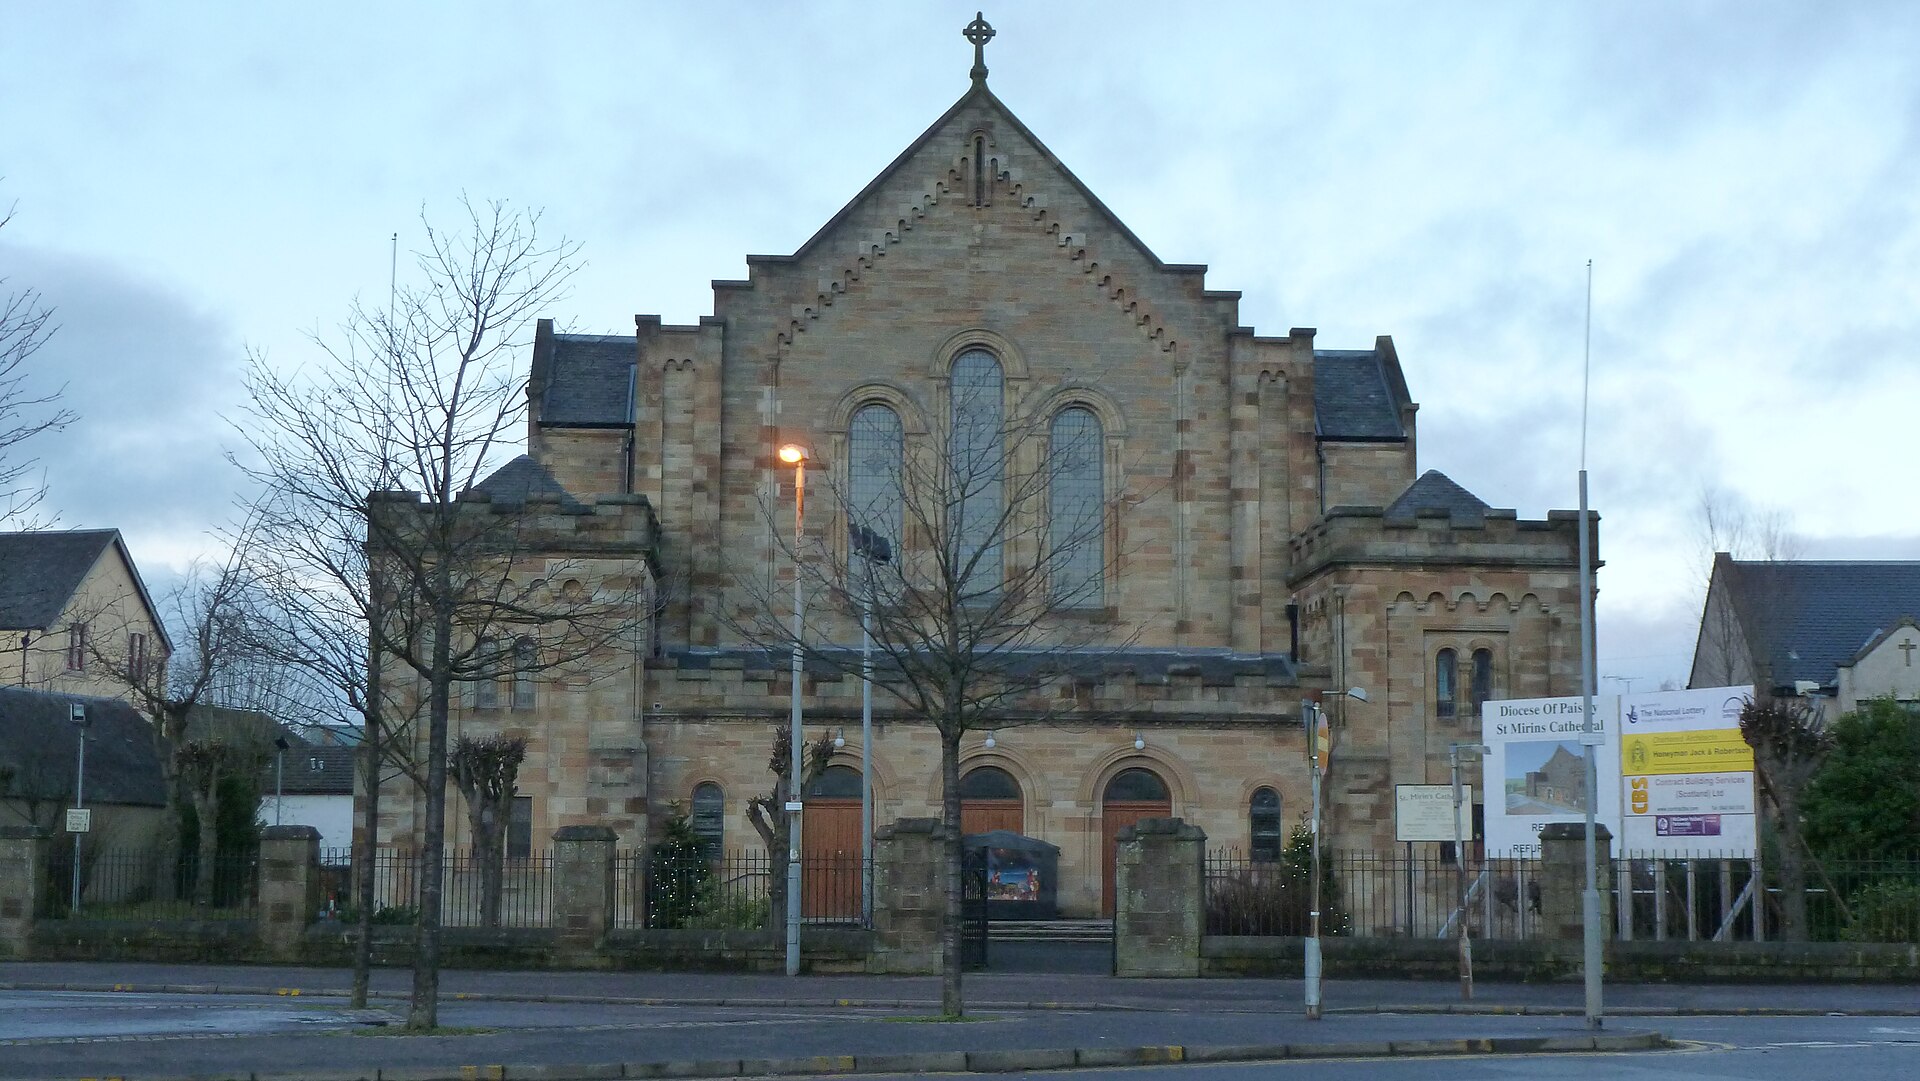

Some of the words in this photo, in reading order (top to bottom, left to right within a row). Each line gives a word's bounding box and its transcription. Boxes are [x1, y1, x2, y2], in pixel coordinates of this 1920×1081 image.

[1500, 705, 1540, 717] Diocese
[1543, 703, 1558, 714] Of
[1560, 702, 1599, 715] Paisy
[1641, 709, 1652, 717] The
[1654, 707, 1681, 717] National
[1682, 706, 1706, 716] Lottery
[1496, 723, 1507, 735] St
[1511, 722, 1547, 734] Mirins
[1655, 778, 1685, 786] Contract
[1685, 777, 1713, 787] Building
[1715, 776, 1745, 784] Services
[1631, 777, 1649, 814] CBS
